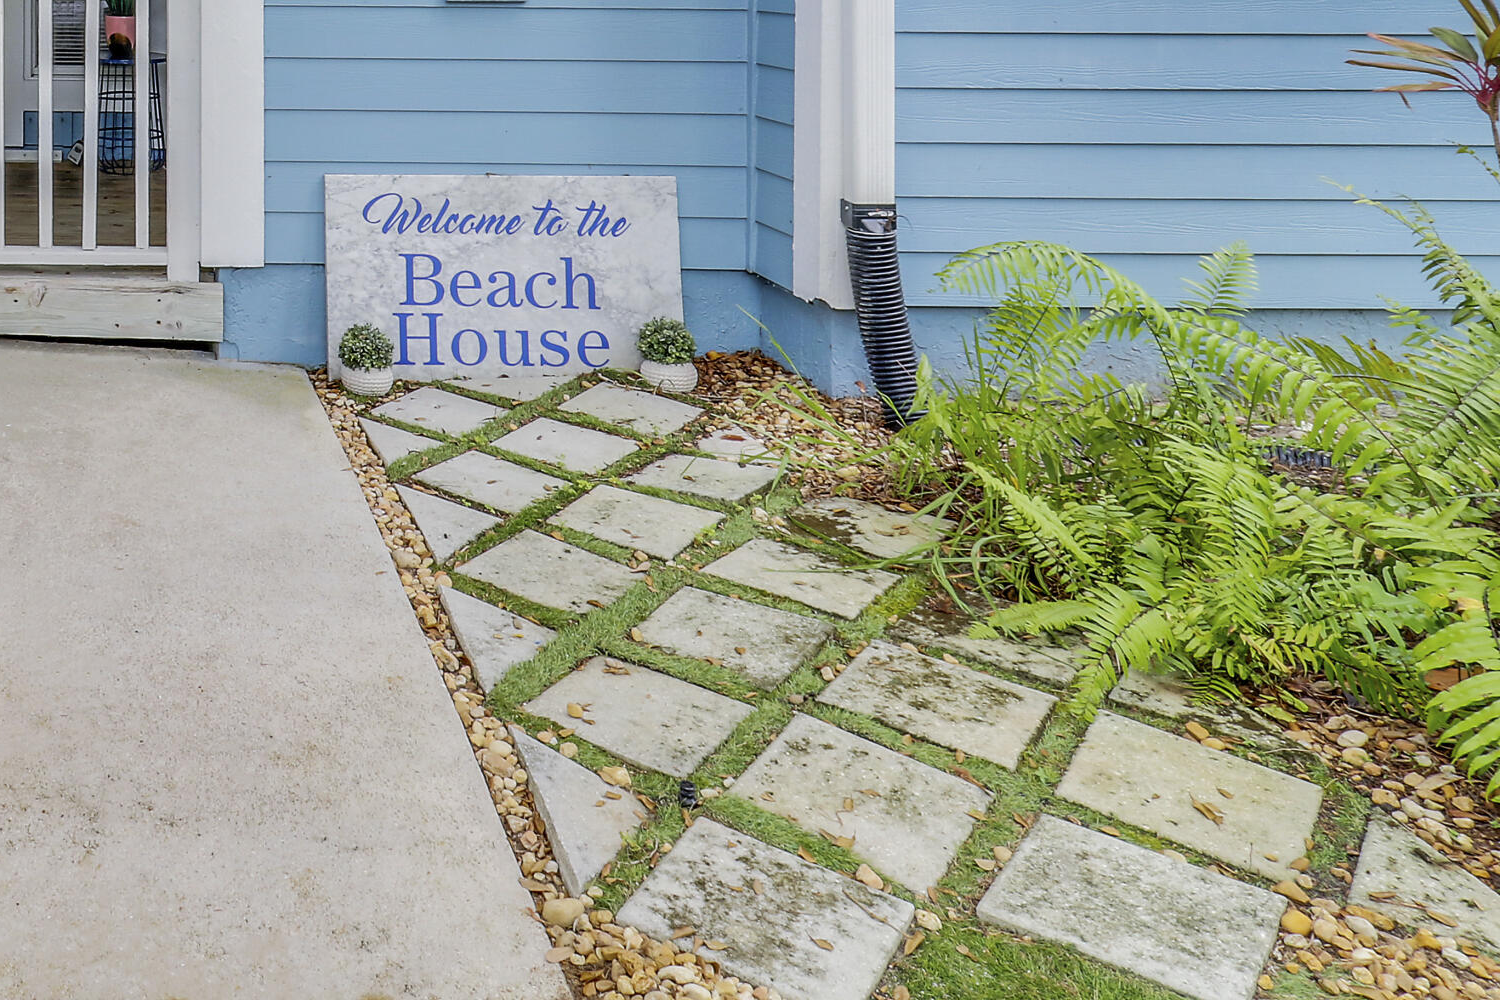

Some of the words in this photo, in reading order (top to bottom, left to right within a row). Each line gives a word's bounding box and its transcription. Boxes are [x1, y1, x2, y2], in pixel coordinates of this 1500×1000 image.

[362, 192, 525, 236] Welcome
[532, 199, 569, 237] to
[575, 200, 631, 238] the
[399, 253, 601, 310] Beach
[393, 312, 610, 368] House
